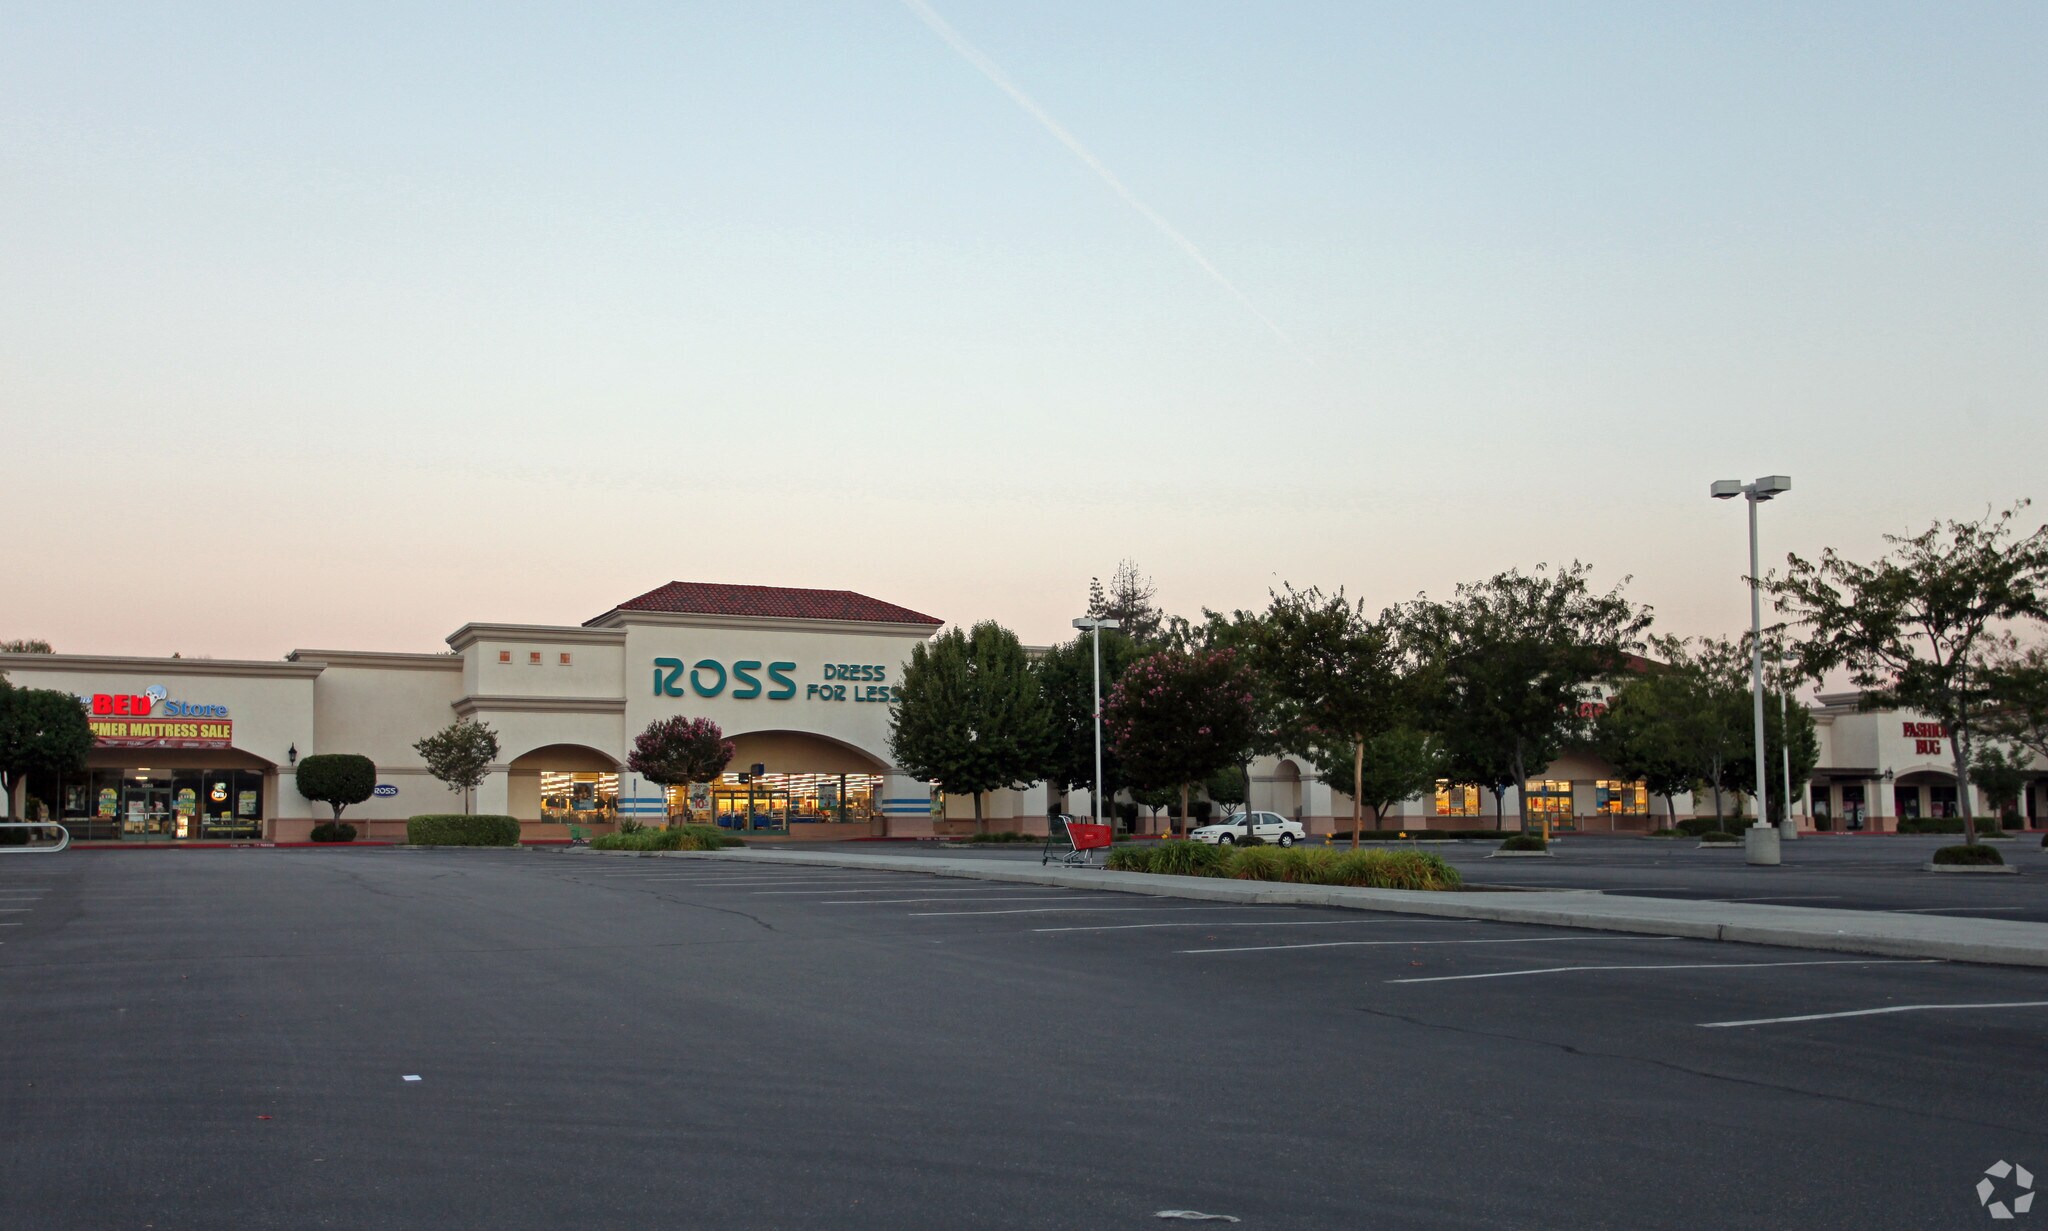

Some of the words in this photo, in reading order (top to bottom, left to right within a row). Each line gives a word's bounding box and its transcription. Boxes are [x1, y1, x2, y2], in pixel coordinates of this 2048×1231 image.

[654, 657, 796, 700] ROSS
[824, 663, 885, 682] DRESS
[807, 684, 847, 702] FOR
[855, 685, 901, 703] LESS
[93, 693, 152, 717] BED
[164, 698, 229, 717] Store
[130, 722, 198, 737] MATTRESS
[201, 724, 231, 738] SALE
[1915, 739, 1941, 755] BUG
[374, 787, 396, 795] ROSS
